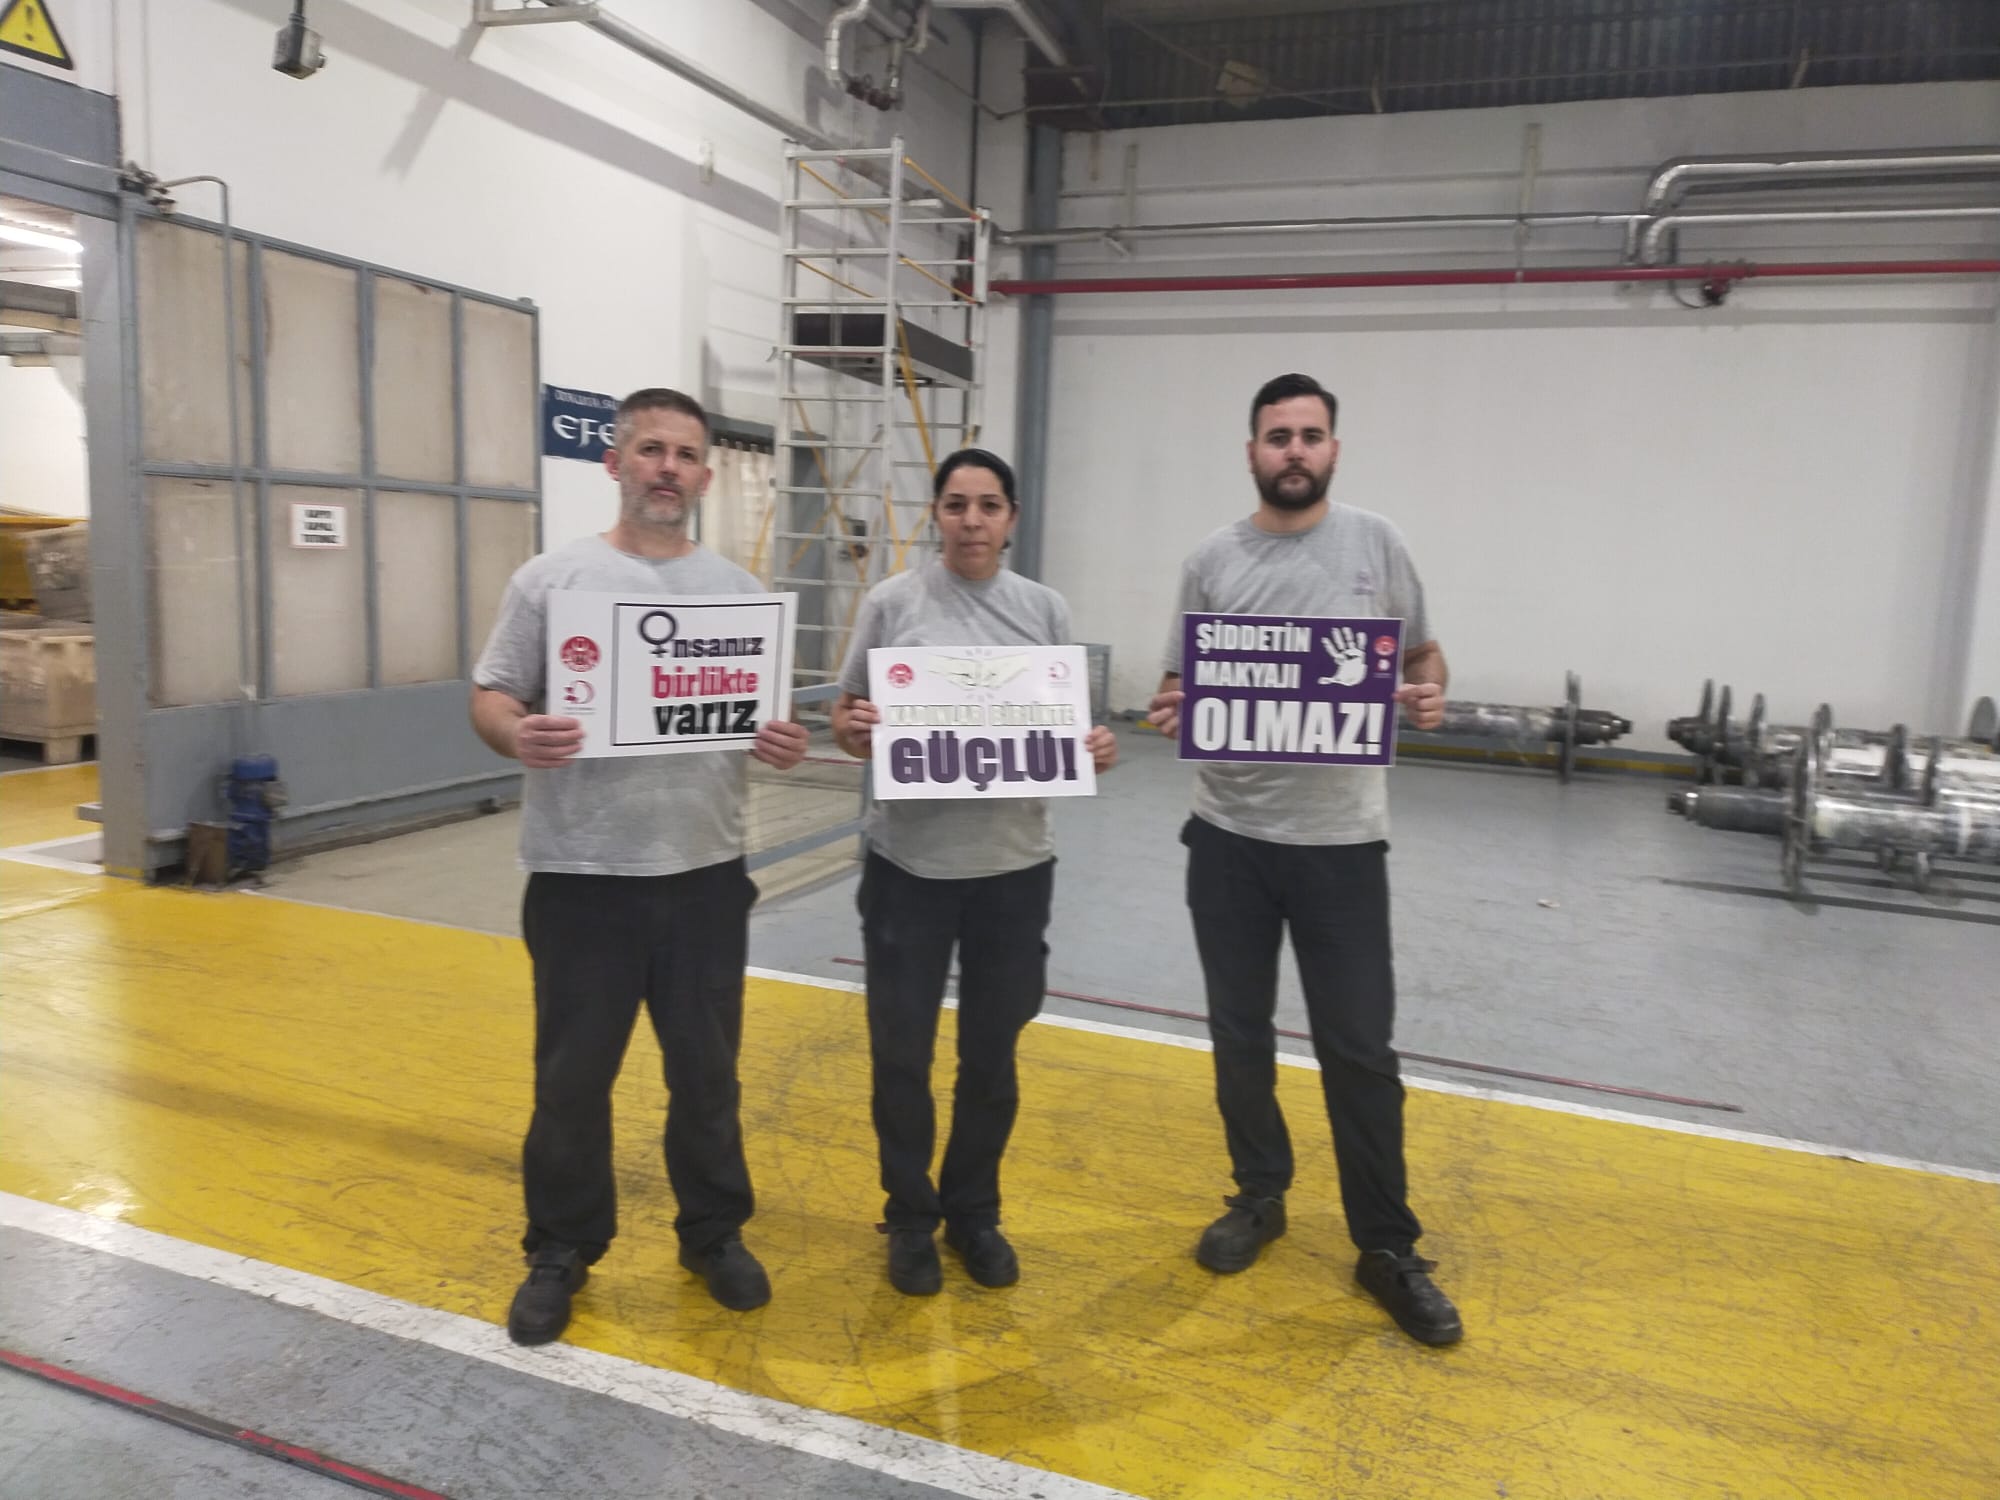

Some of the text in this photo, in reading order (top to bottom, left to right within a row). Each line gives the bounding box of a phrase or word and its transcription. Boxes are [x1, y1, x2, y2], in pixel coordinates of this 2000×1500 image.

[1195, 619, 1312, 654] ŞİDDETİN
[651, 666, 758, 699] birlikte
[1194, 660, 1301, 689] MAKYAJI
[653, 700, 760, 736] varız
[1192, 697, 1386, 755] OLMAZ!
[890, 730, 1078, 792] GÜÇLÜ!
